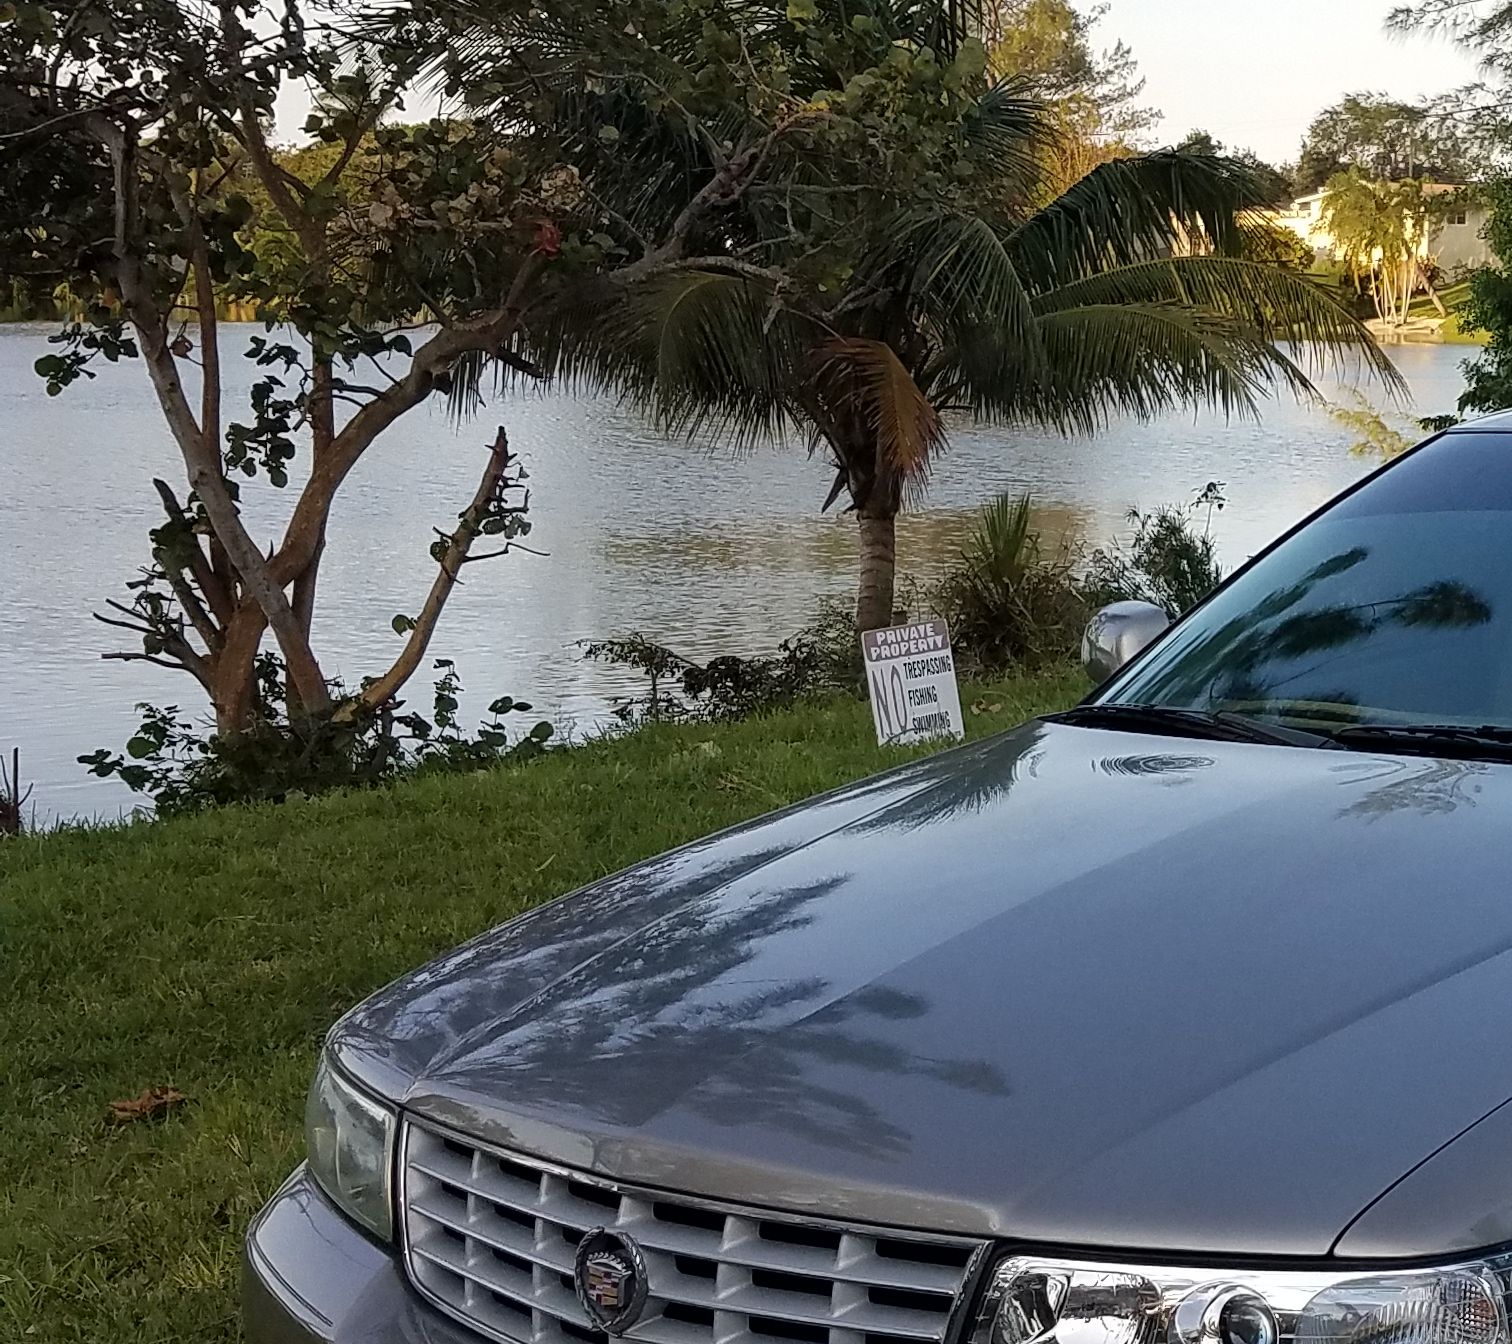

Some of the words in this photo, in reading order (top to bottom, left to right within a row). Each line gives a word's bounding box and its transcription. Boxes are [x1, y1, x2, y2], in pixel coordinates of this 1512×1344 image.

[876, 623, 935, 645] PRIVATE
[870, 635, 944, 661] PROPERTY
[903, 655, 951, 680] TRESPASSING
[872, 664, 907, 739] NO
[907, 685, 938, 707] FISHING
[912, 711, 951, 735] SWIMMING
